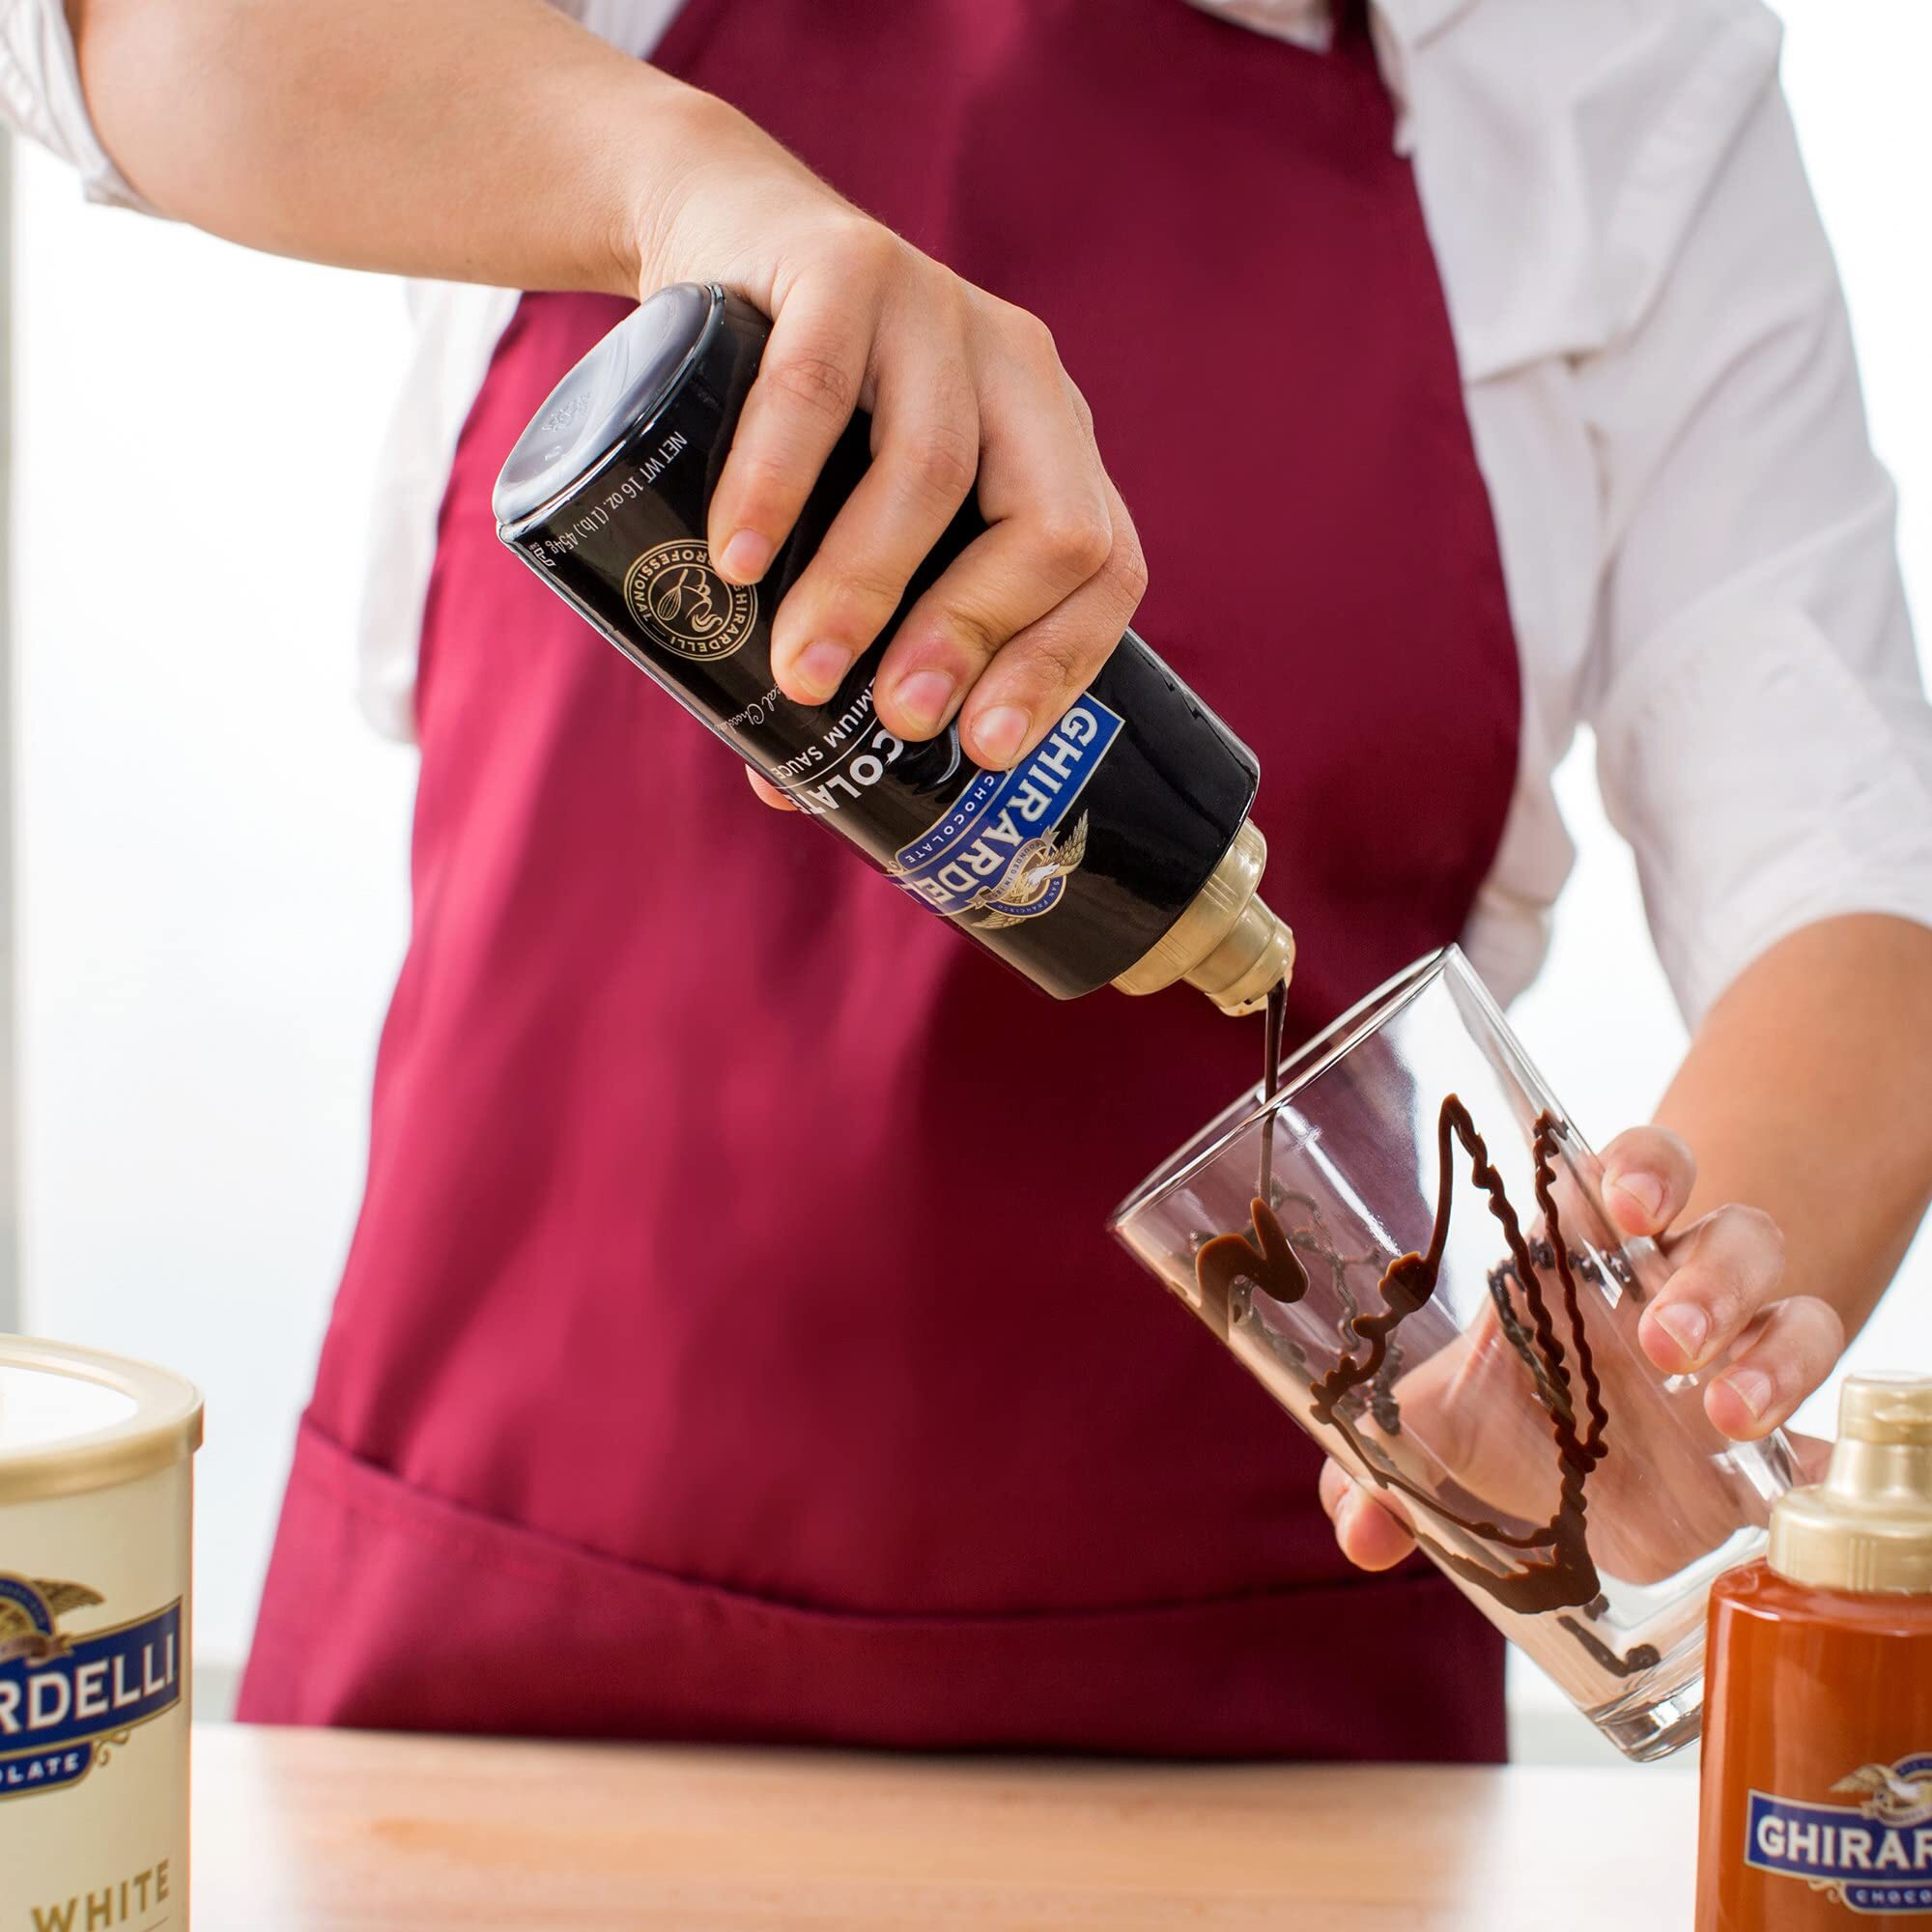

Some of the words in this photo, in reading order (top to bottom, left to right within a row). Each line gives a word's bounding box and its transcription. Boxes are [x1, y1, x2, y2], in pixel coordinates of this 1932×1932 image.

[658, 431, 688, 464] NET
[639, 457, 666, 484] WT
[603, 492, 624, 510] oz.
[620, 476, 644, 498] 16
[545, 532, 579, 554] 454g
[634, 550, 710, 621] ROFESSIONAL
[762, 682, 781, 712] eal
[823, 677, 876, 749] MIUM
[771, 746, 824, 780] SAUCE
[782, 728, 904, 815] COLATE
[905, 775, 995, 864] CHOCOLATE
[1010, 841, 1040, 874] FOUNDED
[1005, 877, 1013, 887] IN
[1049, 880, 1060, 897] SAN
[998, 899, 1048, 913] FRANCISCO
[0, 1633, 176, 1734] RDELLI
[0, 1752, 79, 1784] LATE
[31, 1858, 170, 1932] WHITE
[1855, 1889, 1932, 1904] CHOCO
